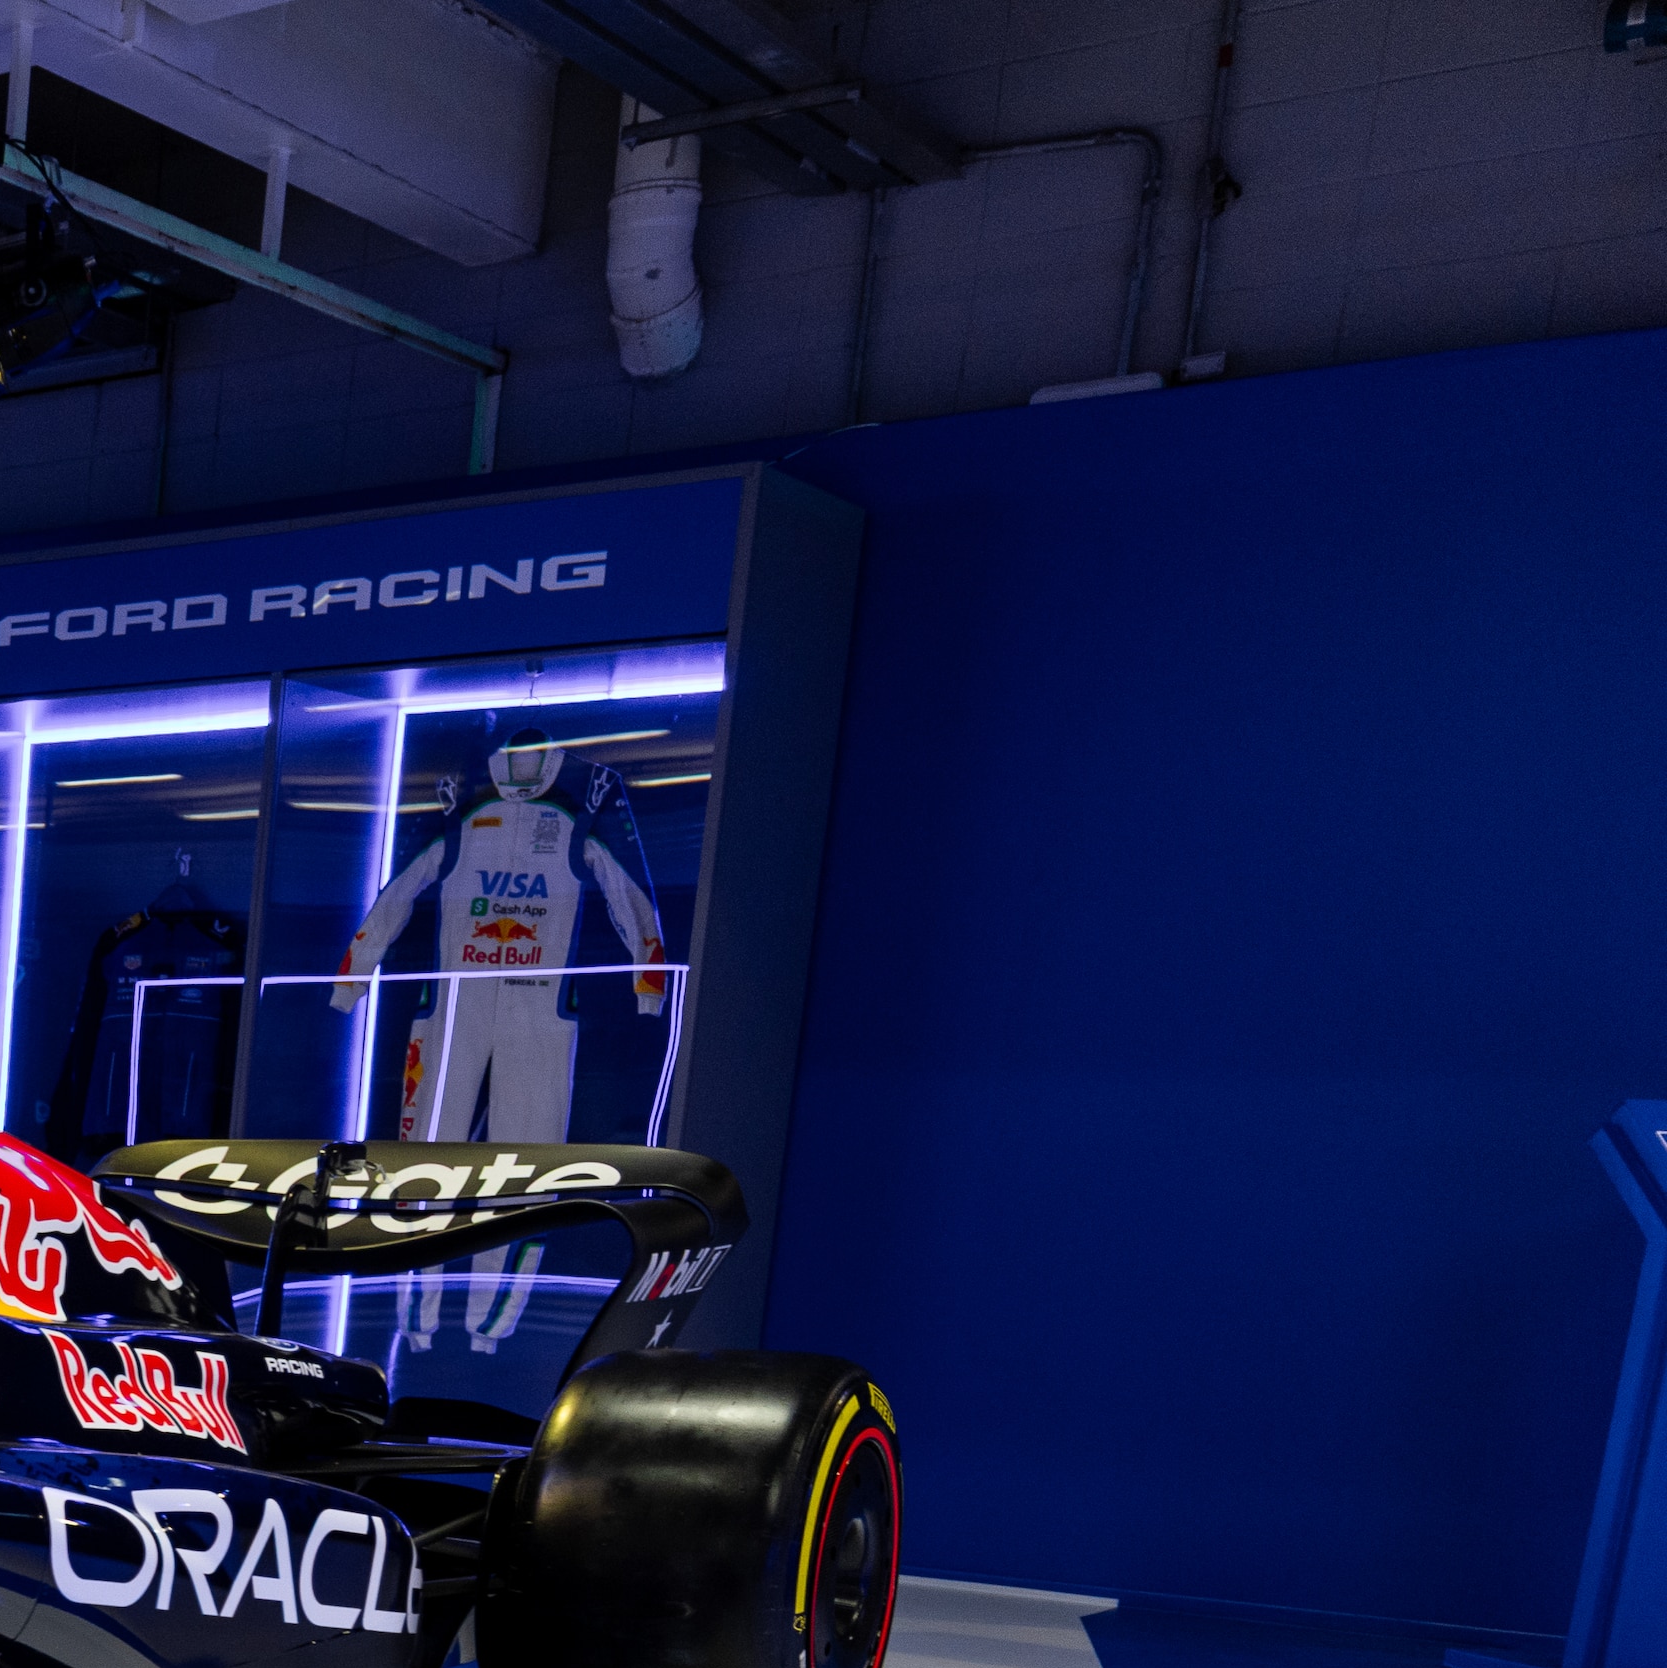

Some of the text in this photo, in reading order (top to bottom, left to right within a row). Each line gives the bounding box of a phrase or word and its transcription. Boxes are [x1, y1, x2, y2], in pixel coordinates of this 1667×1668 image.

[249, 550, 609, 622] RACING
[475, 870, 548, 898] VISA
[492, 903, 547, 917] Cash App
[462, 945, 542, 965] Red Bull
[264, 1356, 326, 1379] RACING
[41, 1328, 248, 1455] Red Bull
